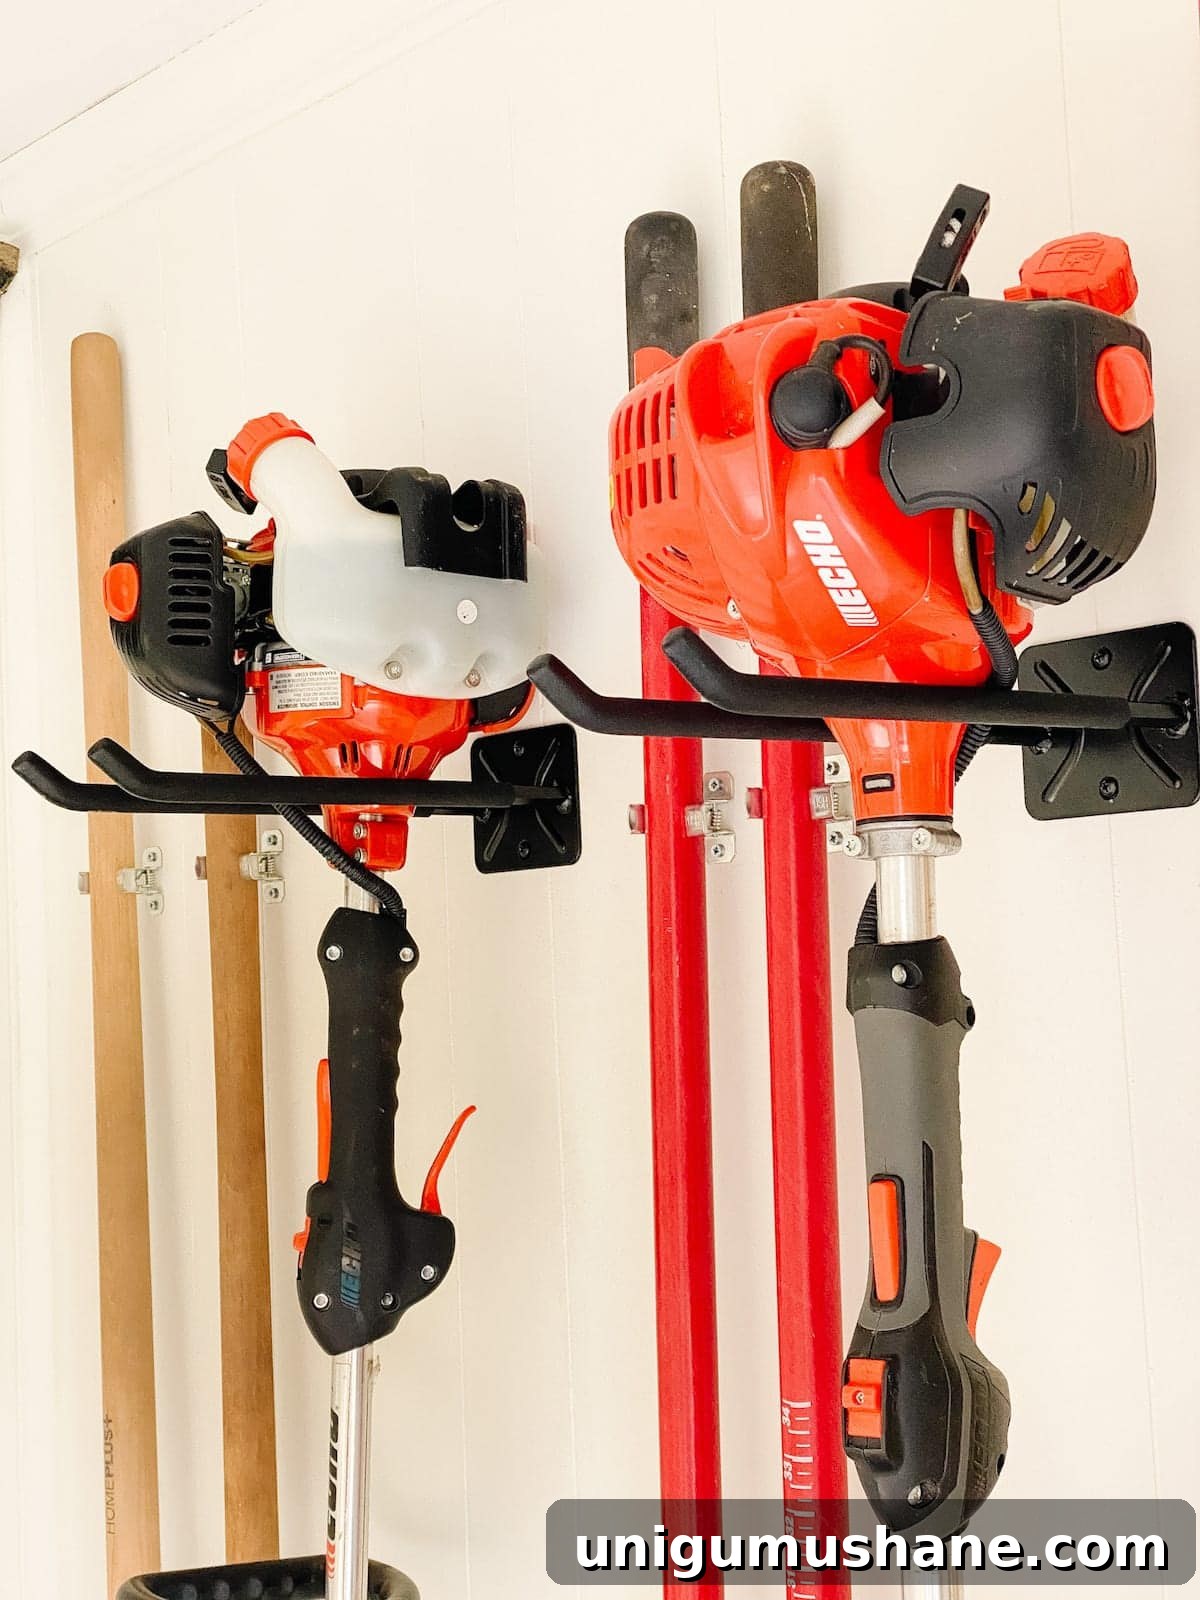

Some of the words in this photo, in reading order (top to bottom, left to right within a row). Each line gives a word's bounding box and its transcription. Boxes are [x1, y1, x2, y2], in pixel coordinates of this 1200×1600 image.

[792, 514, 880, 627] ECHO
[781, 1406, 791, 1427] 34
[783, 1461, 793, 1481] 33
